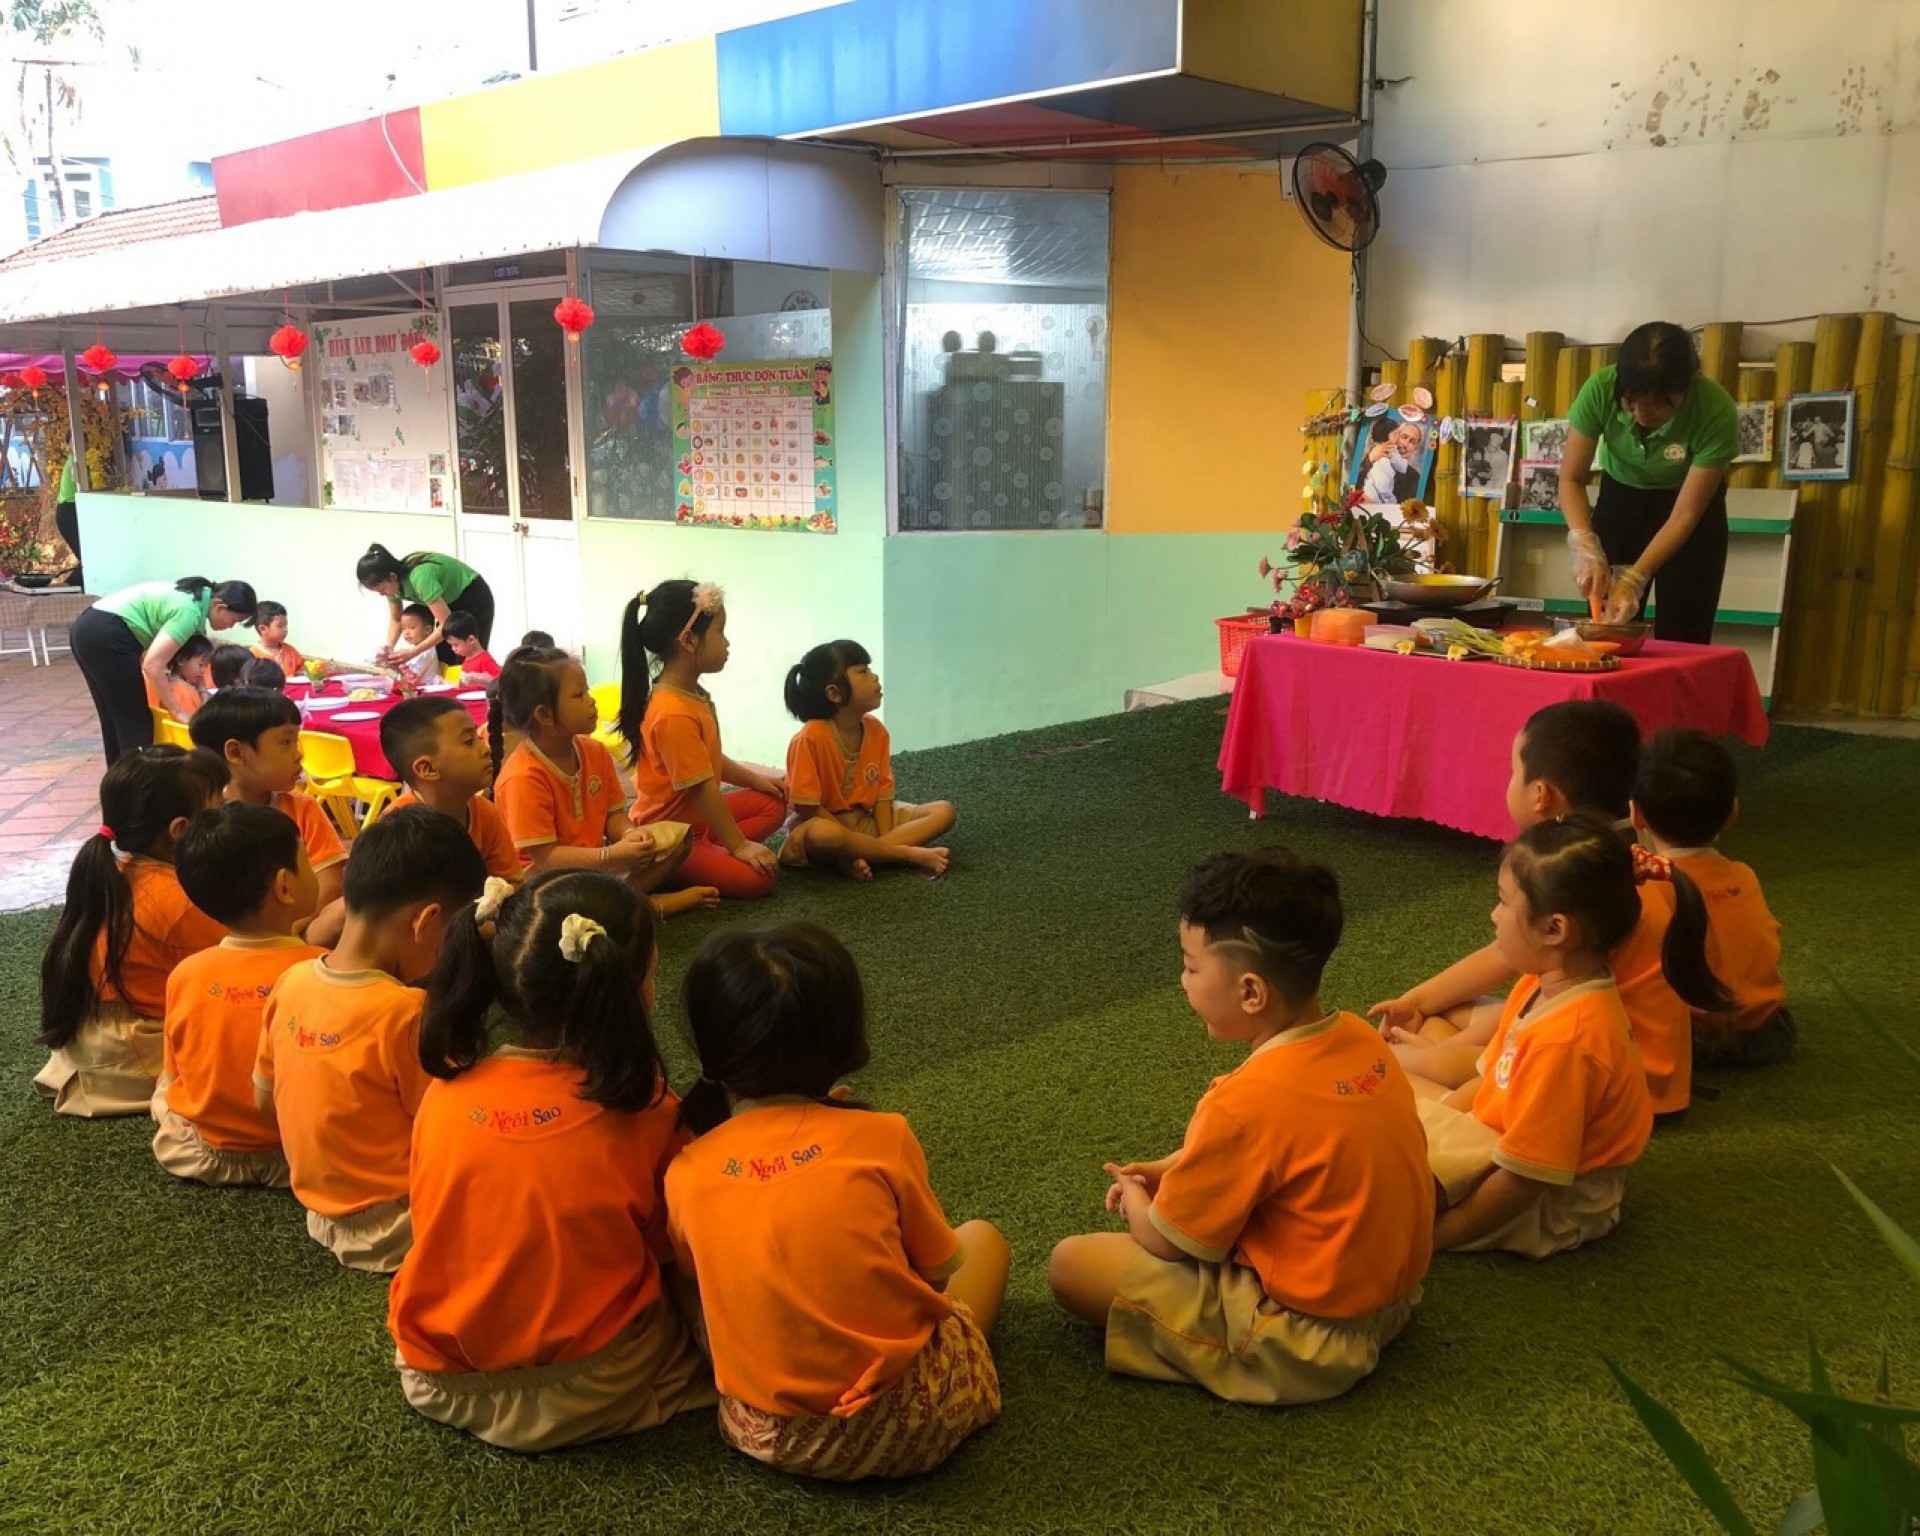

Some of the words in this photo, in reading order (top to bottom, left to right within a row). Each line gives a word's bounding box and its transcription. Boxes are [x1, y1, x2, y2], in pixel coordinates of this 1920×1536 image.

[320, 1033, 341, 1047] Sao
[532, 1106, 561, 1125] Sao
[791, 1143, 822, 1167] Sao
